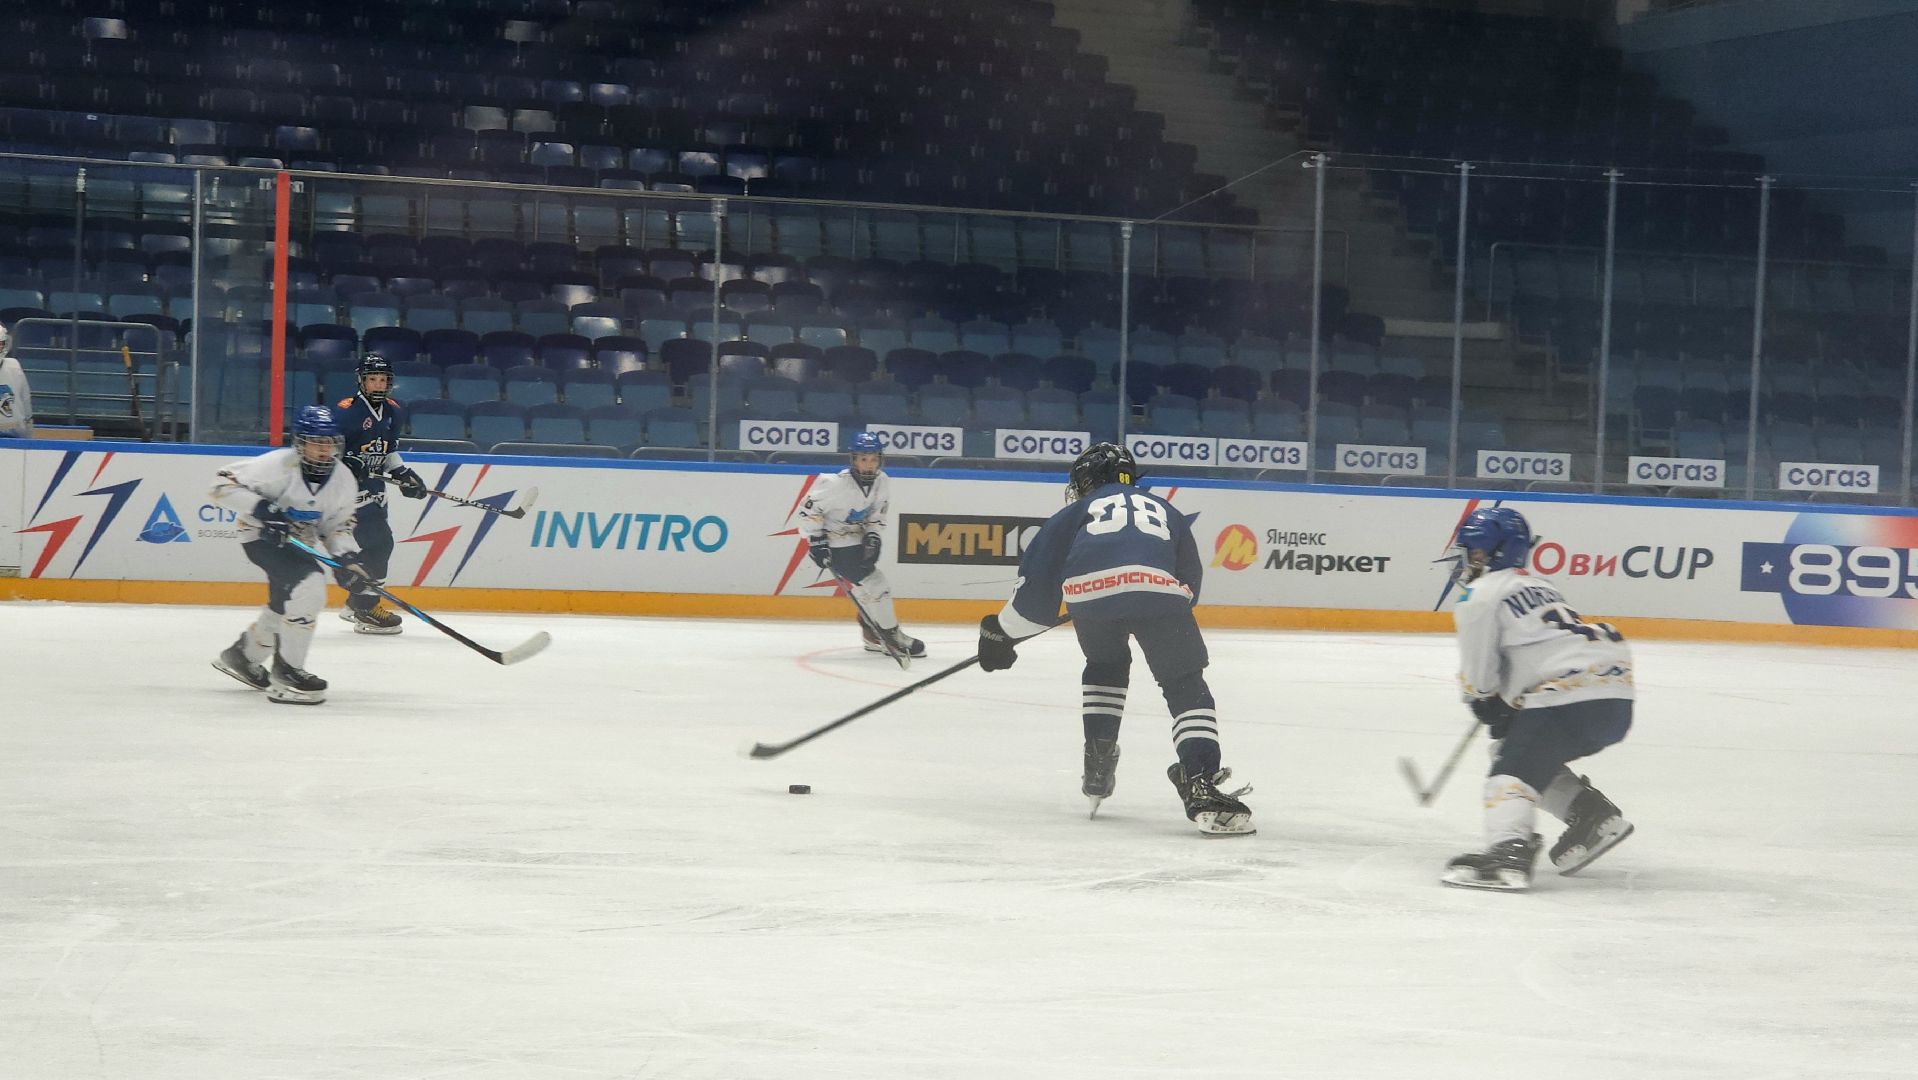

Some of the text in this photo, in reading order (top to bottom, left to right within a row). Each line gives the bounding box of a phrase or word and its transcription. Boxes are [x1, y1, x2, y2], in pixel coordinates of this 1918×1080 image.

[530, 510, 729, 553] INVITRO
[1266, 529, 1327, 547] Яндекс
[1264, 549, 1391, 575] Маркет
[1513, 542, 1714, 580] ОвиCUP
